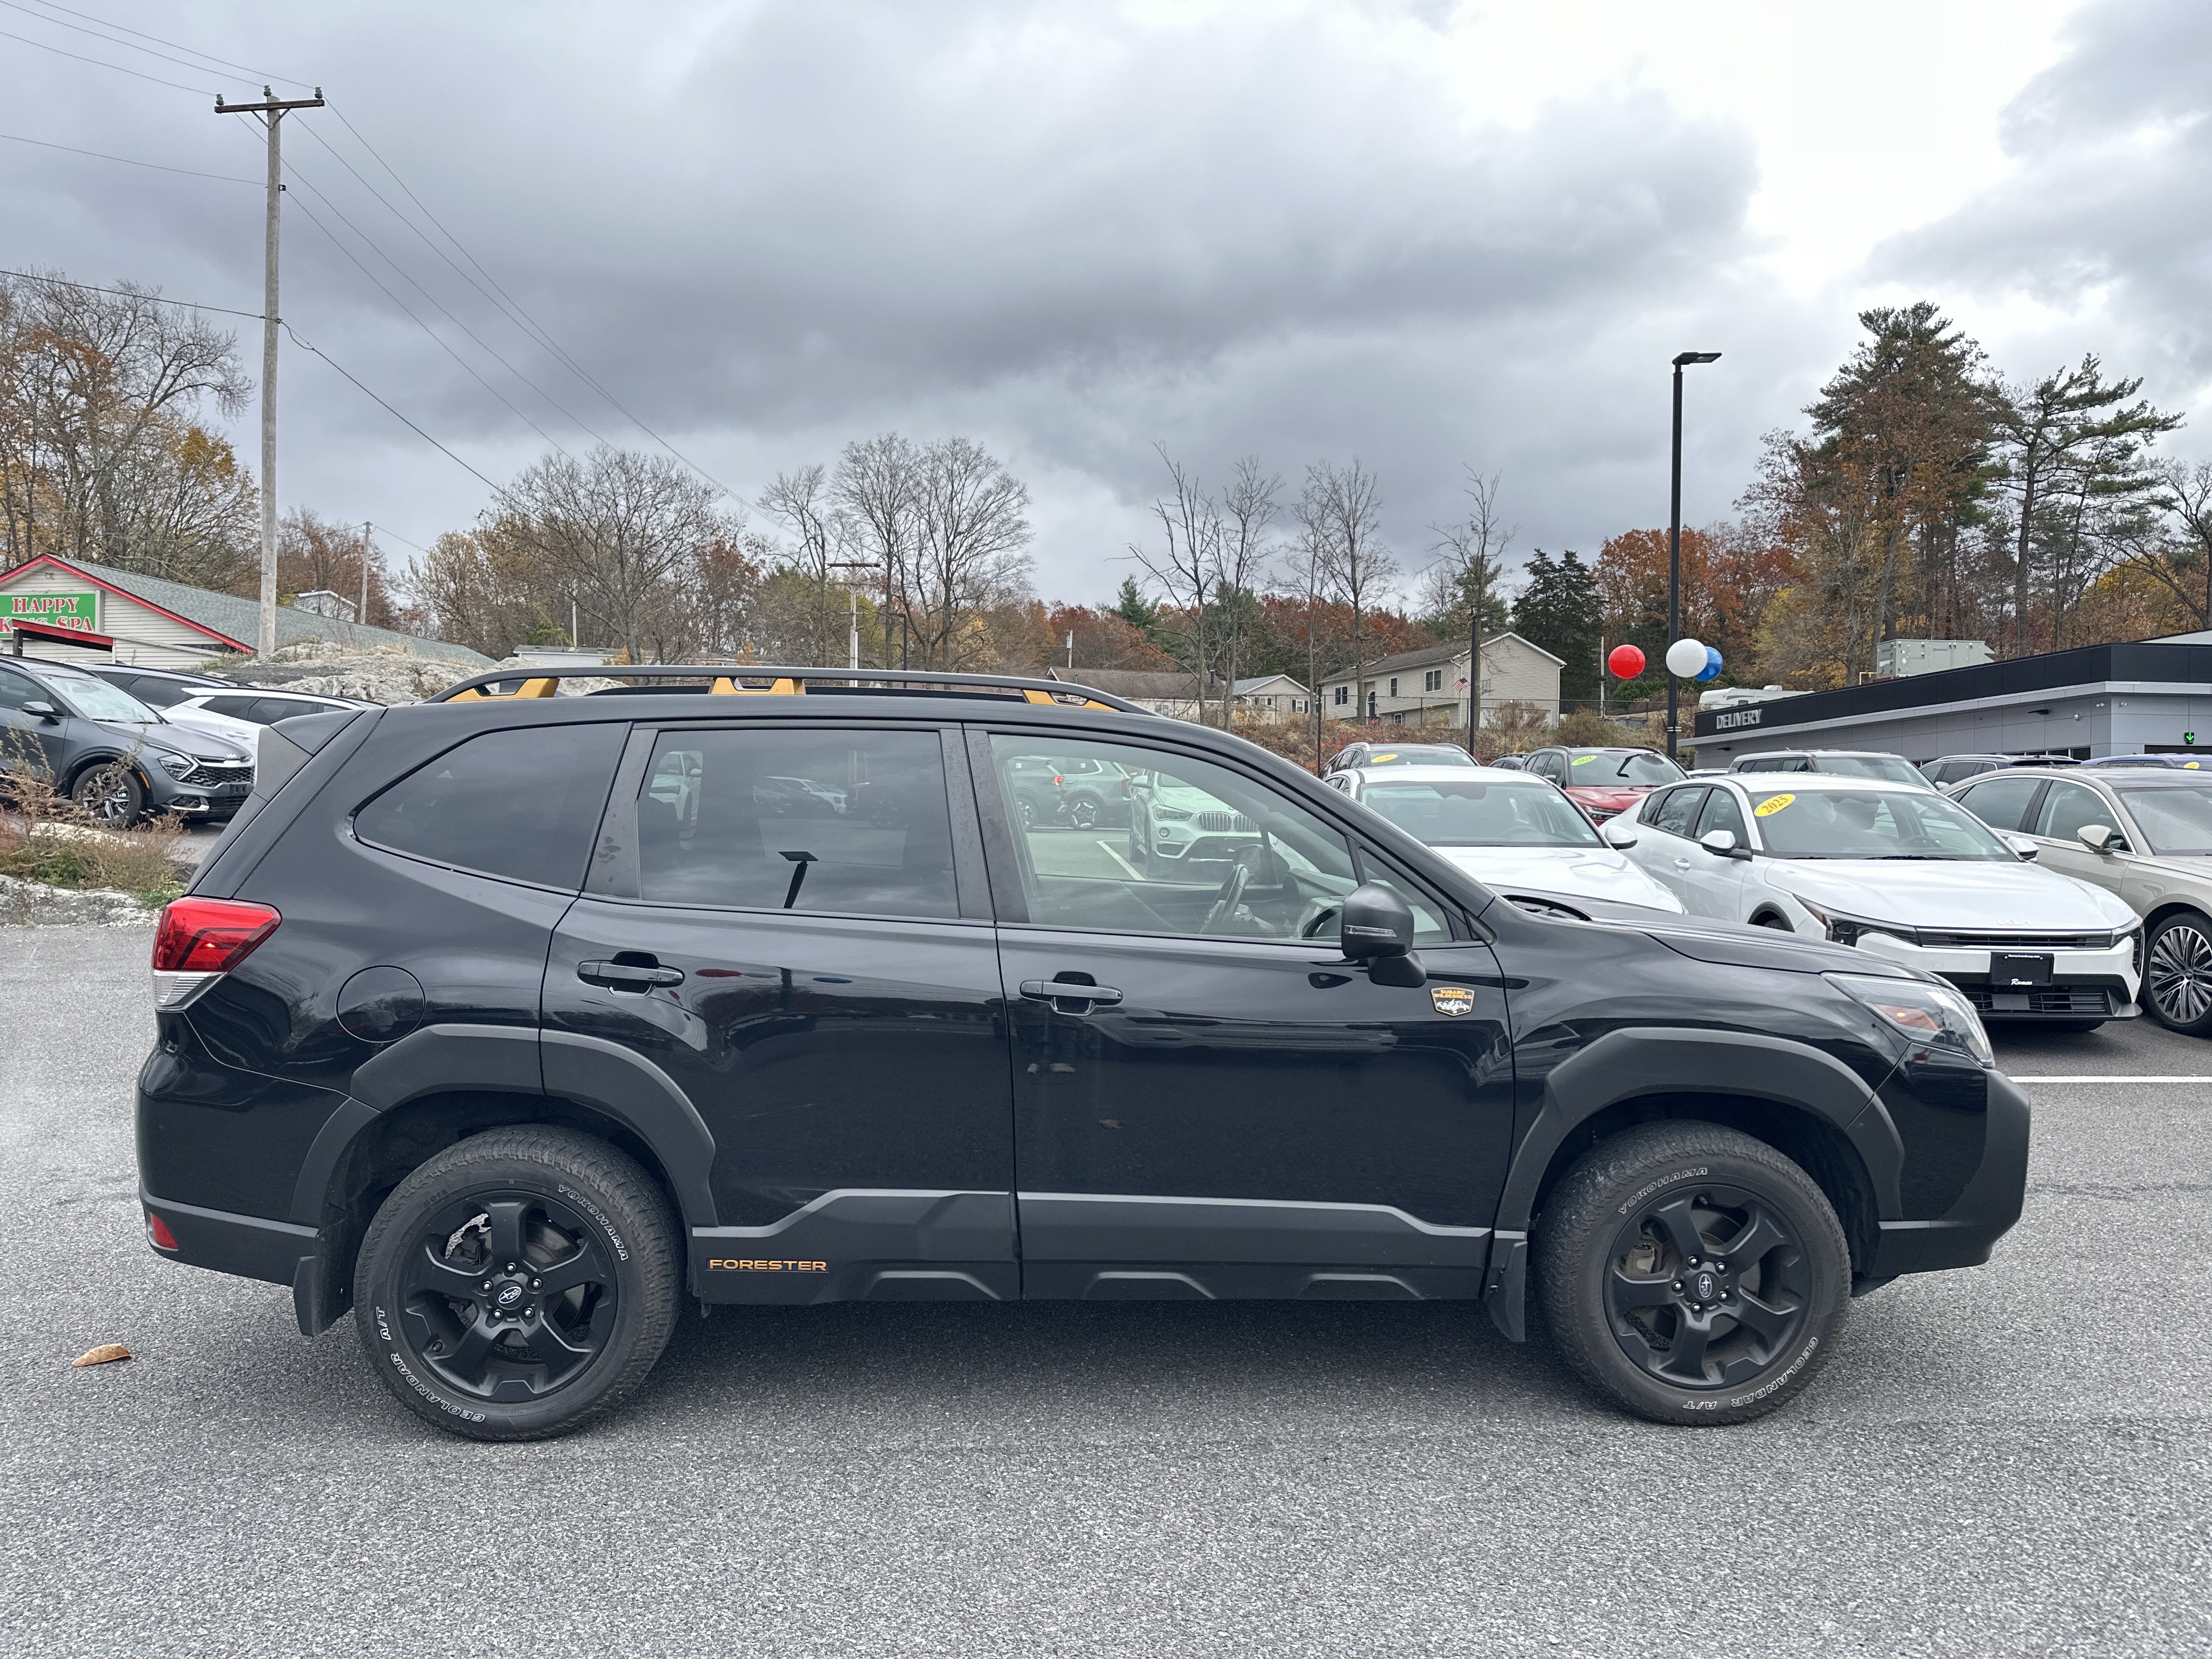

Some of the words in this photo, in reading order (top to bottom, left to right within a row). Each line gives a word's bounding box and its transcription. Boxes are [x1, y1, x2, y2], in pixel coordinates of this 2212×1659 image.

[12, 597, 80, 614] HAPPY
[56, 616, 94, 631] SPA
[1716, 708, 1762, 730] DELIVERY
[1577, 756, 1592, 764] 2021
[1762, 796, 1788, 813] 2025
[1618, 1167, 1708, 1215] YOKOHAMA
[558, 1184, 629, 1261] YOKOHAMA
[709, 1259, 827, 1271] FORESTER
[375, 1306, 392, 1341] A/T
[1730, 1337, 1819, 1408] GEOLANDAR
[390, 1352, 486, 1424] GEOLANDAR
[1683, 1400, 1717, 1410] A/T
